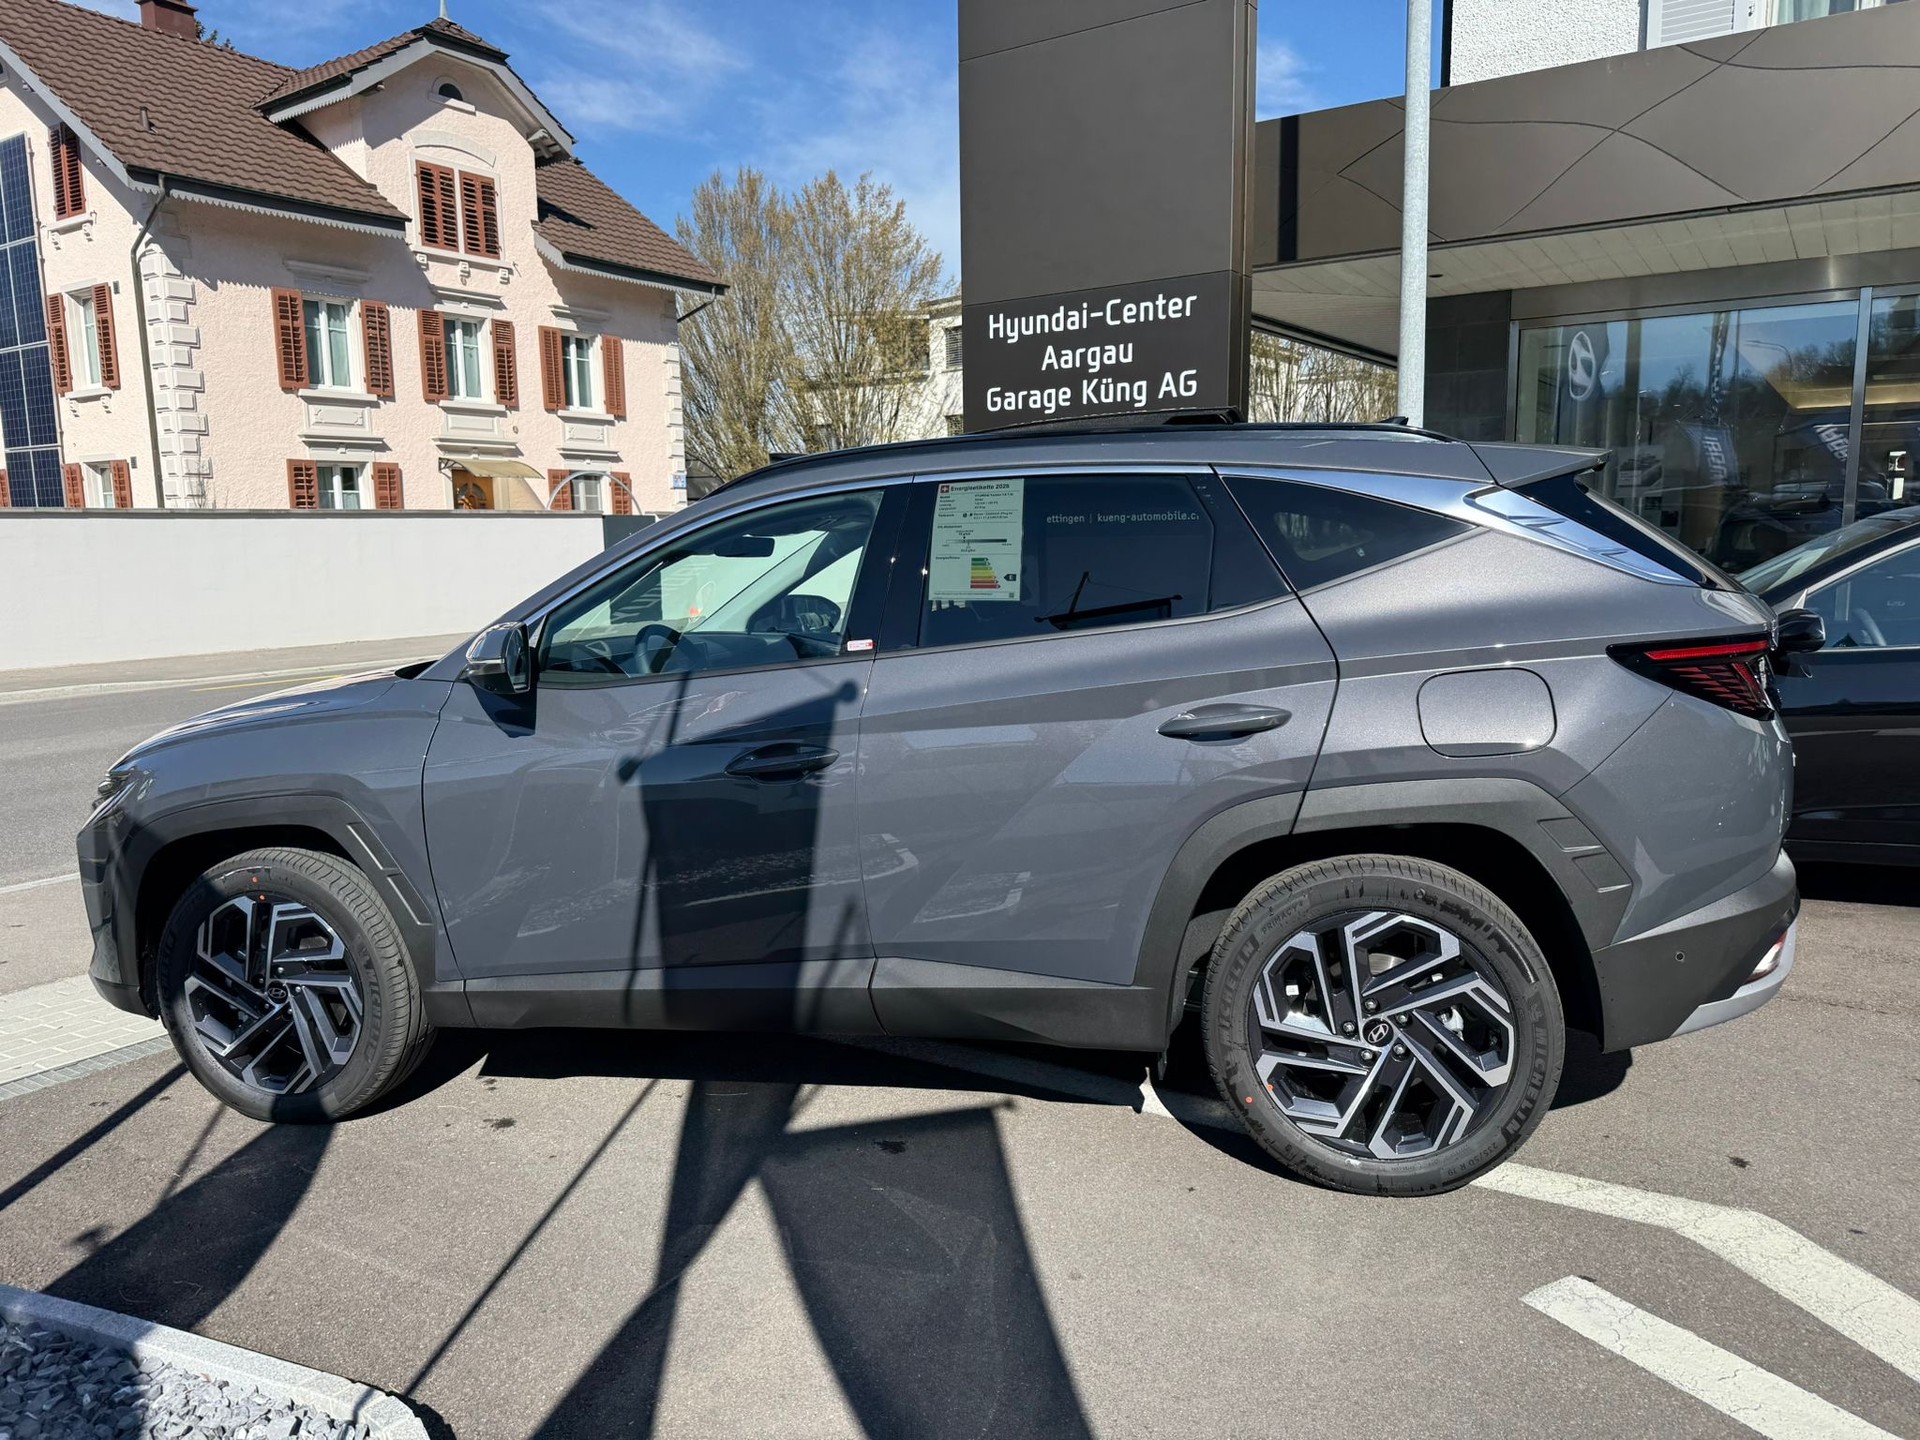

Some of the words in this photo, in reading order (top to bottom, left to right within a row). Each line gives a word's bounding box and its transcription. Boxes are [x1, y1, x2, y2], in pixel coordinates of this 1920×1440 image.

[988, 293, 1197, 343] Hyundai-Center
[1041, 343, 1133, 373] Aargau
[986, 386, 1071, 414] Garage
[1082, 378, 1147, 407] Küng
[1158, 369, 1197, 399] AG
[1097, 510, 1200, 524] kueng-automobile.c
